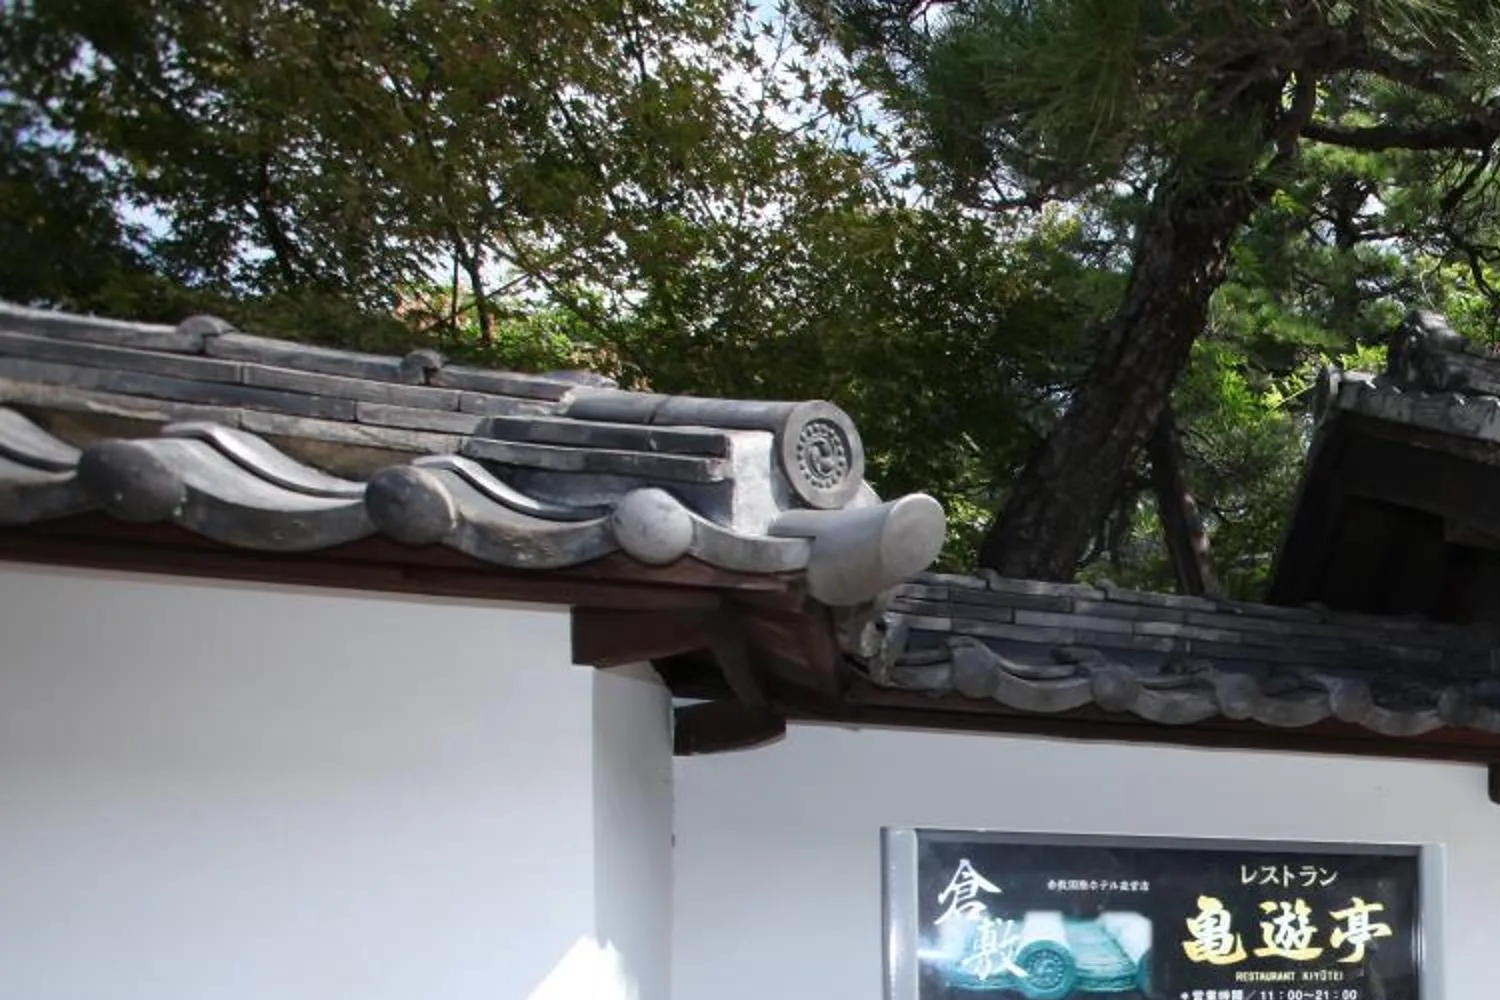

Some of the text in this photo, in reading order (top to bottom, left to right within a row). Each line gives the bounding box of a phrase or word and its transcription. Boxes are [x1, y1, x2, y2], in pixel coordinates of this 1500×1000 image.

[1240, 864, 1338, 887] レストラン
[1182, 895, 1392, 964] 亀遊亭
[1235, 971, 1295, 982] RESTAURANT
